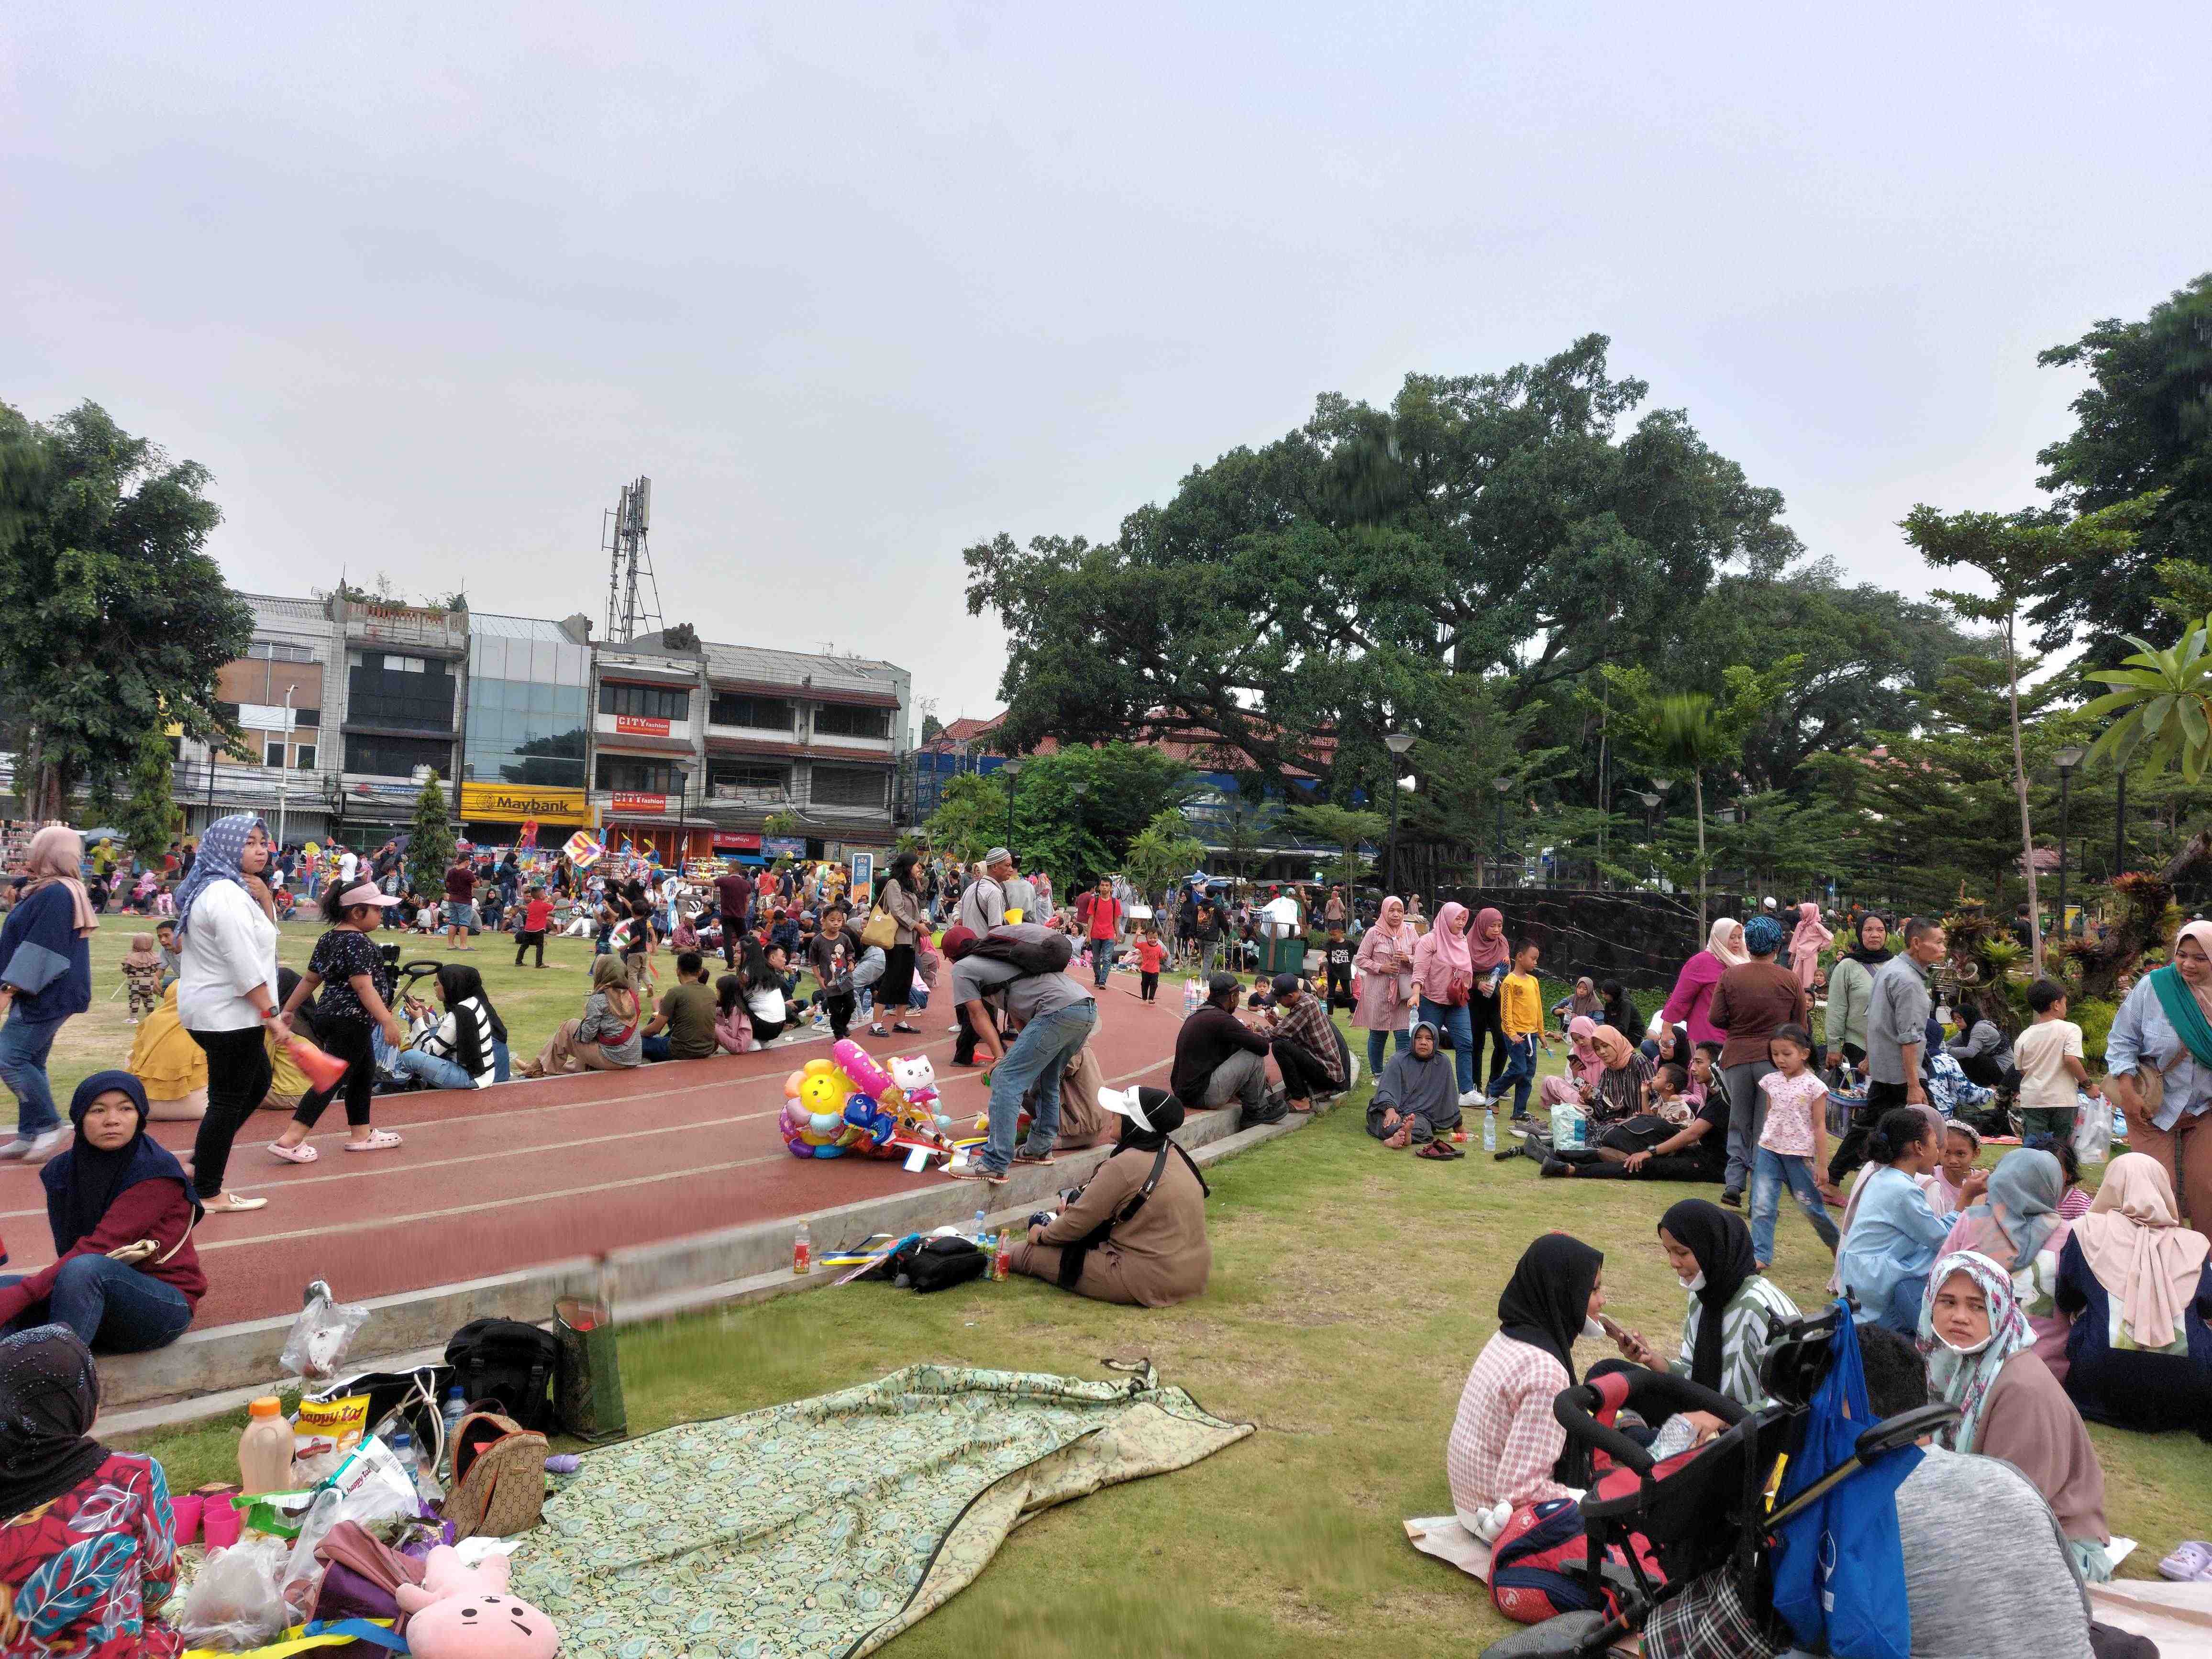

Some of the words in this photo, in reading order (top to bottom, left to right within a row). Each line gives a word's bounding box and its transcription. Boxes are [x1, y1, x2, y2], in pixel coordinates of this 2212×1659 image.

[619, 717, 646, 727] CITY
[497, 796, 569, 813] Maybank
[614, 792, 642, 803] CITY
[298, 1408, 338, 1427] happy
[346, 1475, 364, 1494] happy
